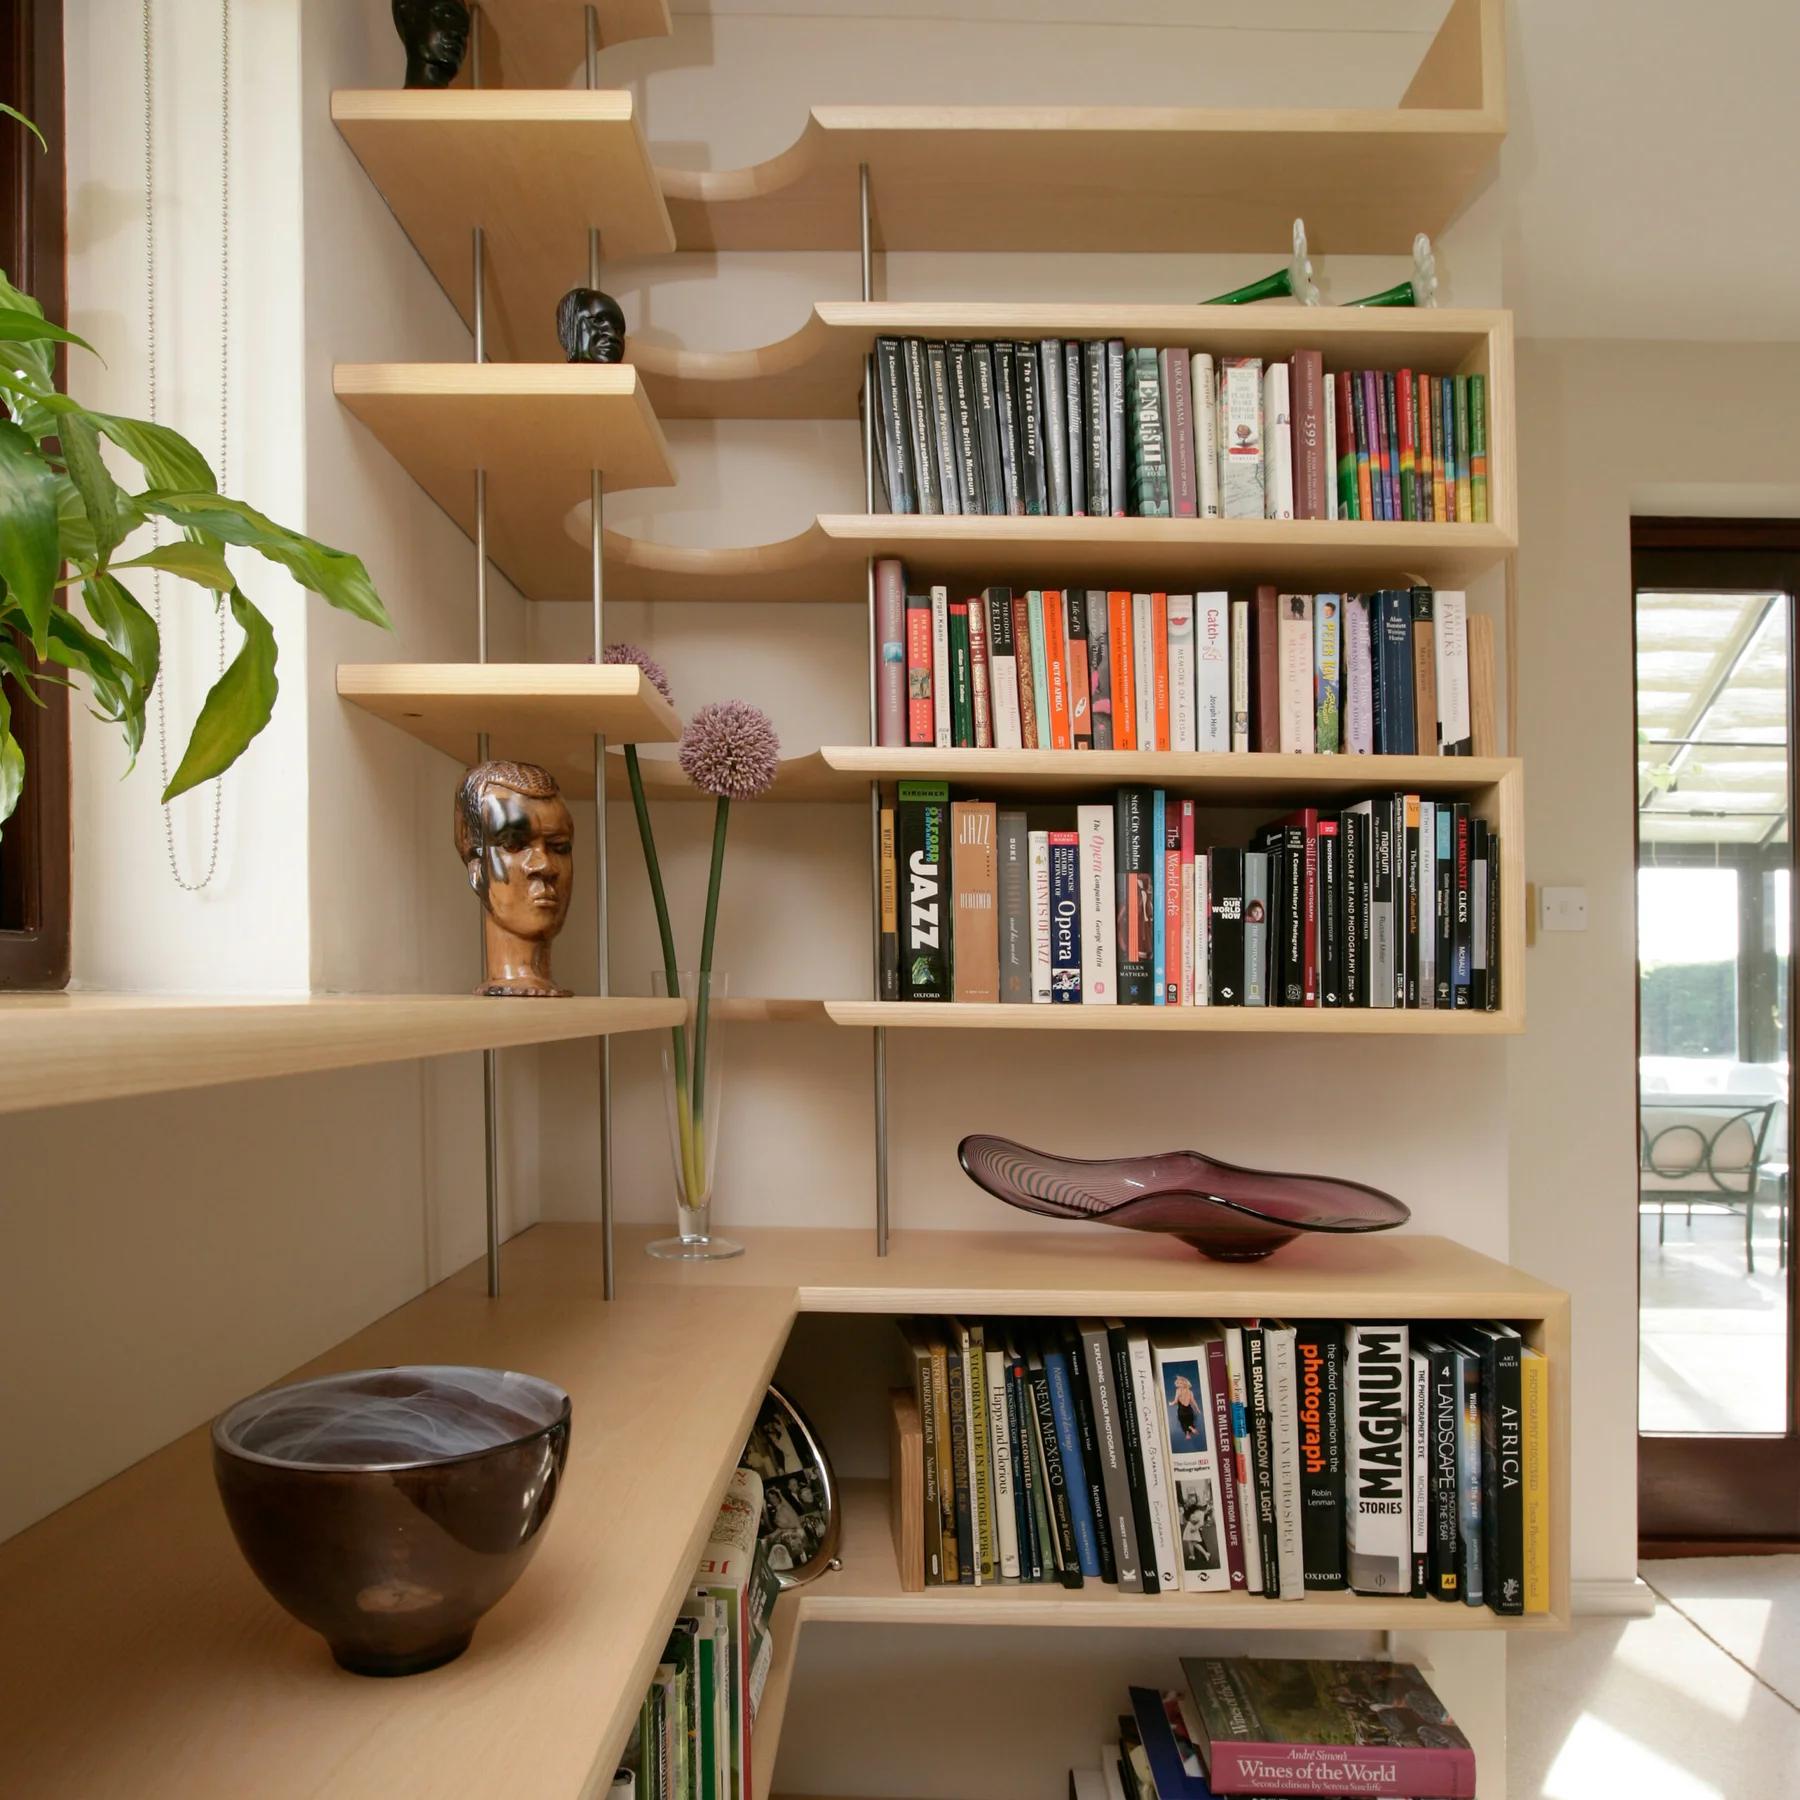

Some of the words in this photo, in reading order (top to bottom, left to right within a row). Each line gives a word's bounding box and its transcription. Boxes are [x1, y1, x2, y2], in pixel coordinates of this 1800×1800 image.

[955, 355, 965, 398] Treasures
[979, 361, 988, 393] African
[1110, 353, 1123, 395] Japanese
[1174, 360, 1182, 394] BARACK
[910, 341, 922, 399] Encyclopaedia
[917, 400, 923, 408] of
[920, 442, 930, 493] architecture
[960, 400, 967, 409] of
[1113, 396, 1123, 413] Art
[1026, 415, 1036, 456] Gallery
[1094, 419, 1100, 428] of
[1305, 414, 1316, 447] 1599
[963, 428, 972, 456] British
[966, 459, 975, 495] Museum
[992, 601, 1001, 644] ZELDIN
[1002, 602, 1010, 644] THEODORE
[1073, 616, 1079, 624] of
[1443, 603, 1454, 657] FAULKS
[1322, 621, 1335, 656] PETER
[1054, 677, 1060, 685] OF
[1322, 660, 1335, 681] KAY
[1131, 794, 1139, 814] Steel
[930, 807, 939, 863] OXFORD
[1093, 820, 1101, 831] The
[1131, 816, 1140, 834] City
[1168, 826, 1178, 848] The
[1347, 818, 1355, 846] AARON
[925, 853, 931, 863] TO
[1089, 835, 1104, 873] Opera
[1132, 836, 1140, 870] Scholars
[1307, 837, 1315, 856] Still
[1380, 831, 1389, 874] magnum
[1167, 854, 1179, 887] World
[1306, 858, 1315, 877] Life
[1347, 849, 1355, 878] SCHARF
[1037, 870, 1049, 916] GIANTS
[1055, 886, 1061, 897] OF
[1094, 875, 1102, 912] Companion
[1347, 881, 1355, 894] ART
[1459, 879, 1466, 890] IT
[910, 850, 939, 949] JAZZ
[1167, 889, 1179, 917] Café
[1037, 920, 1048, 933] OF
[1055, 900, 1075, 960] Opera
[1095, 920, 1103, 943] George
[1291, 920, 1299, 962] Photography
[1037, 937, 1049, 964] JAZZ
[1458, 946, 1466, 976] McNALLY
[1093, 1343, 1105, 1383] EXPLORING
[1250, 1340, 1261, 1364] BILL
[1277, 1343, 1287, 1371] EVE
[1327, 1344, 1337, 1359] the
[970, 1354, 982, 1418] VICTORIAN
[1327, 1361, 1338, 1391] oxford
[992, 1385, 1005, 1422] Happy
[1100, 1385, 1110, 1415] COLOUR
[1215, 1393, 1225, 1412] LEE
[1252, 1366, 1266, 1416] BRANDT:
[1278, 1375, 1289, 1432] ARNOLD
[1298, 1344, 1326, 1473] photograph
[1326, 1393, 1338, 1443] companion
[1358, 1333, 1403, 1499] MAGNUM
[1417, 1384, 1426, 1444] PHOTOGRAPHER'S
[973, 1424, 983, 1448] LIFE
[995, 1424, 1005, 1445] and
[1103, 1416, 1117, 1469] PHOTOGRAPHY
[1218, 1414, 1229, 1452] MILLER
[1255, 1418, 1269, 1468] SHADOW
[1438, 1384, 1455, 1489] LANDSCAPE
[1501, 1405, 1519, 1489] AFRICA
[976, 1453, 984, 1465] IN
[1020, 1428, 1032, 1489] BEACONSFIELD
[1281, 1440, 1290, 1456] IN
[1328, 1446, 1338, 1456] to
[1418, 1446, 1426, 1458] EYE
[996, 1447, 1009, 1495] Glorious
[1223, 1458, 1233, 1499] PORTRAITS
[1260, 1471, 1269, 1487] OF
[1330, 1458, 1339, 1473] the
[1417, 1475, 1425, 1504] MICHAEL
[1440, 1491, 1448, 1505] OF
[977, 1471, 989, 1558] PHOTOGRAPHS
[1226, 1500, 1235, 1521] FROM
[1261, 1490, 1272, 1524] LIGHT
[1281, 1461, 1295, 1557] RETROSPECT
[1360, 1502, 1402, 1514] STORIES
[1440, 1507, 1448, 1520] THE
[1119, 1516, 1127, 1537] ROBERT
[1417, 1507, 1425, 1537] FREEMAN
[1440, 1521, 1449, 1541] YEAR
[1121, 1539, 1129, 1559] HIRSCH
[1230, 1530, 1238, 1546] LIFE
[1305, 1572, 1341, 1580] OXFORD
[1288, 1749, 1315, 1761] André
[1315, 1749, 1348, 1761] Simon's
[1237, 1760, 1294, 1779] Wines
[1296, 1759, 1315, 1779] of
[1316, 1759, 1344, 1779] the
[1343, 1759, 1396, 1782] World
[1251, 1780, 1282, 1790] Second
[1283, 1780, 1312, 1790] edition
[1313, 1781, 1322, 1793] by
[1324, 1781, 1349, 1791] Serena
[1351, 1781, 1382, 1792] Sutcliffe
